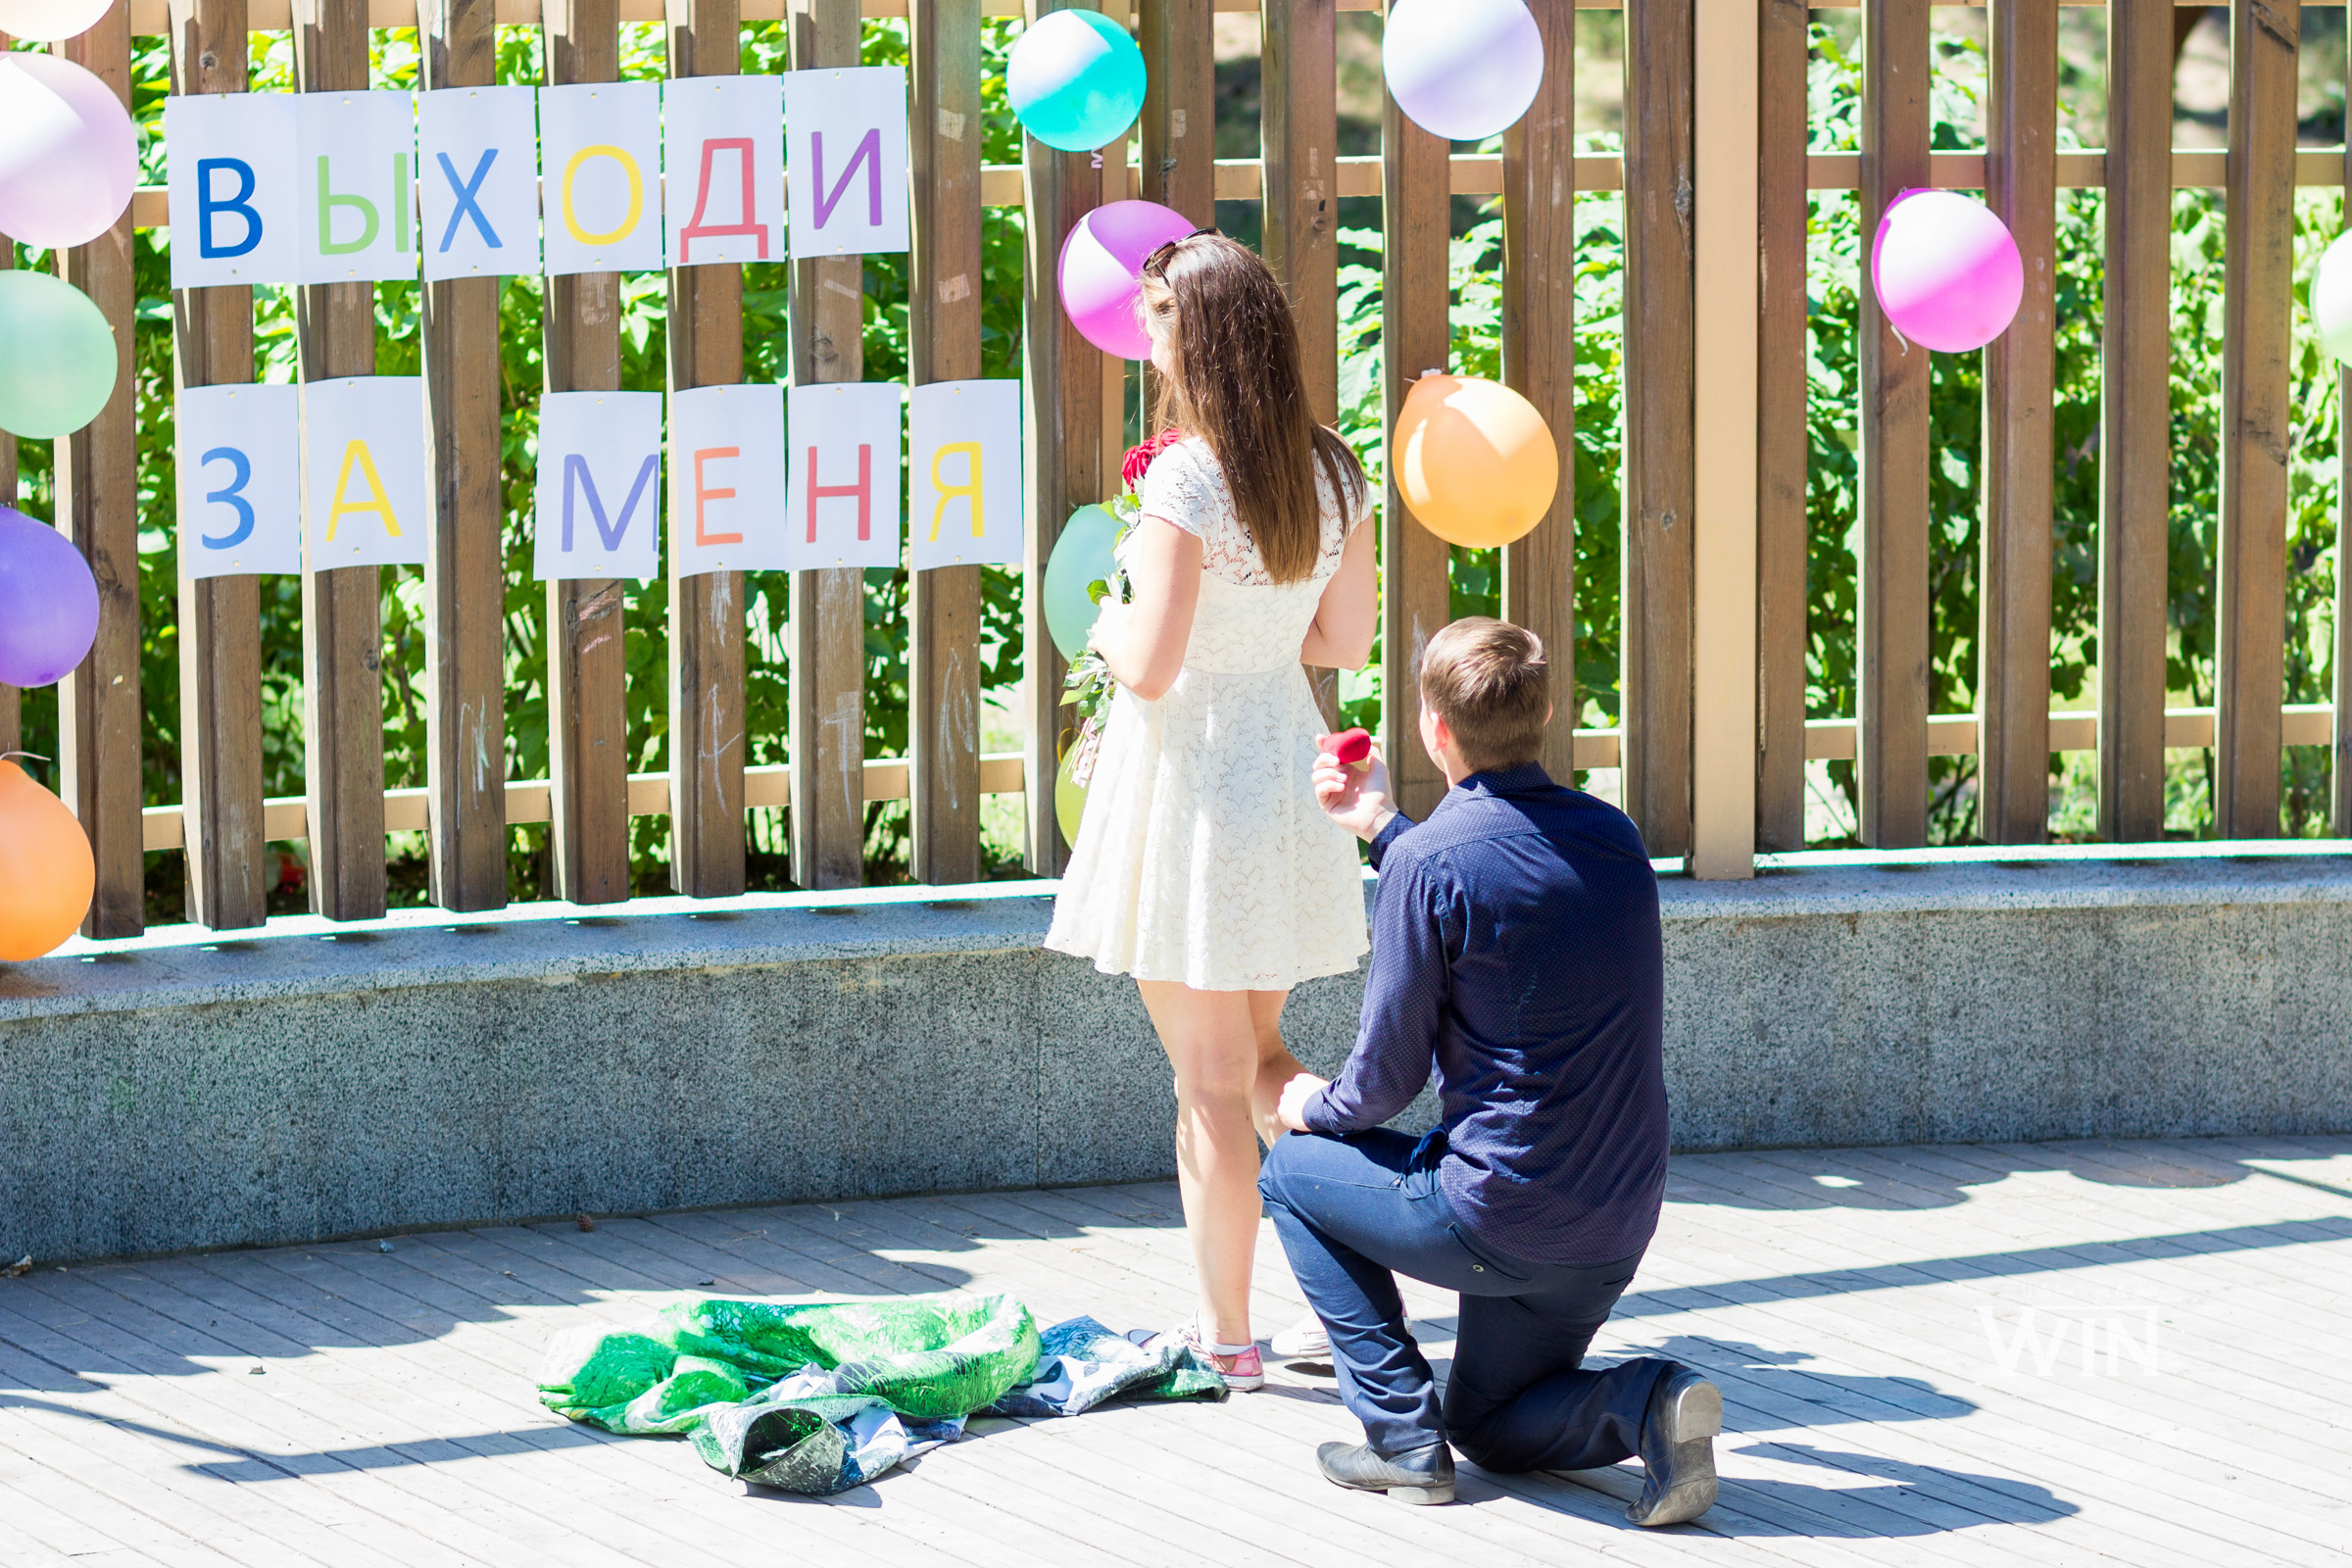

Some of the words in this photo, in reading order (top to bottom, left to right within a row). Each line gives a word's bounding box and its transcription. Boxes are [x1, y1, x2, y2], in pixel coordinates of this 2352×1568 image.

[196, 127, 882, 265] ВЫХОДИ
[200, 439, 403, 551] ЗА
[562, 441, 985, 553] МЕНЯ
